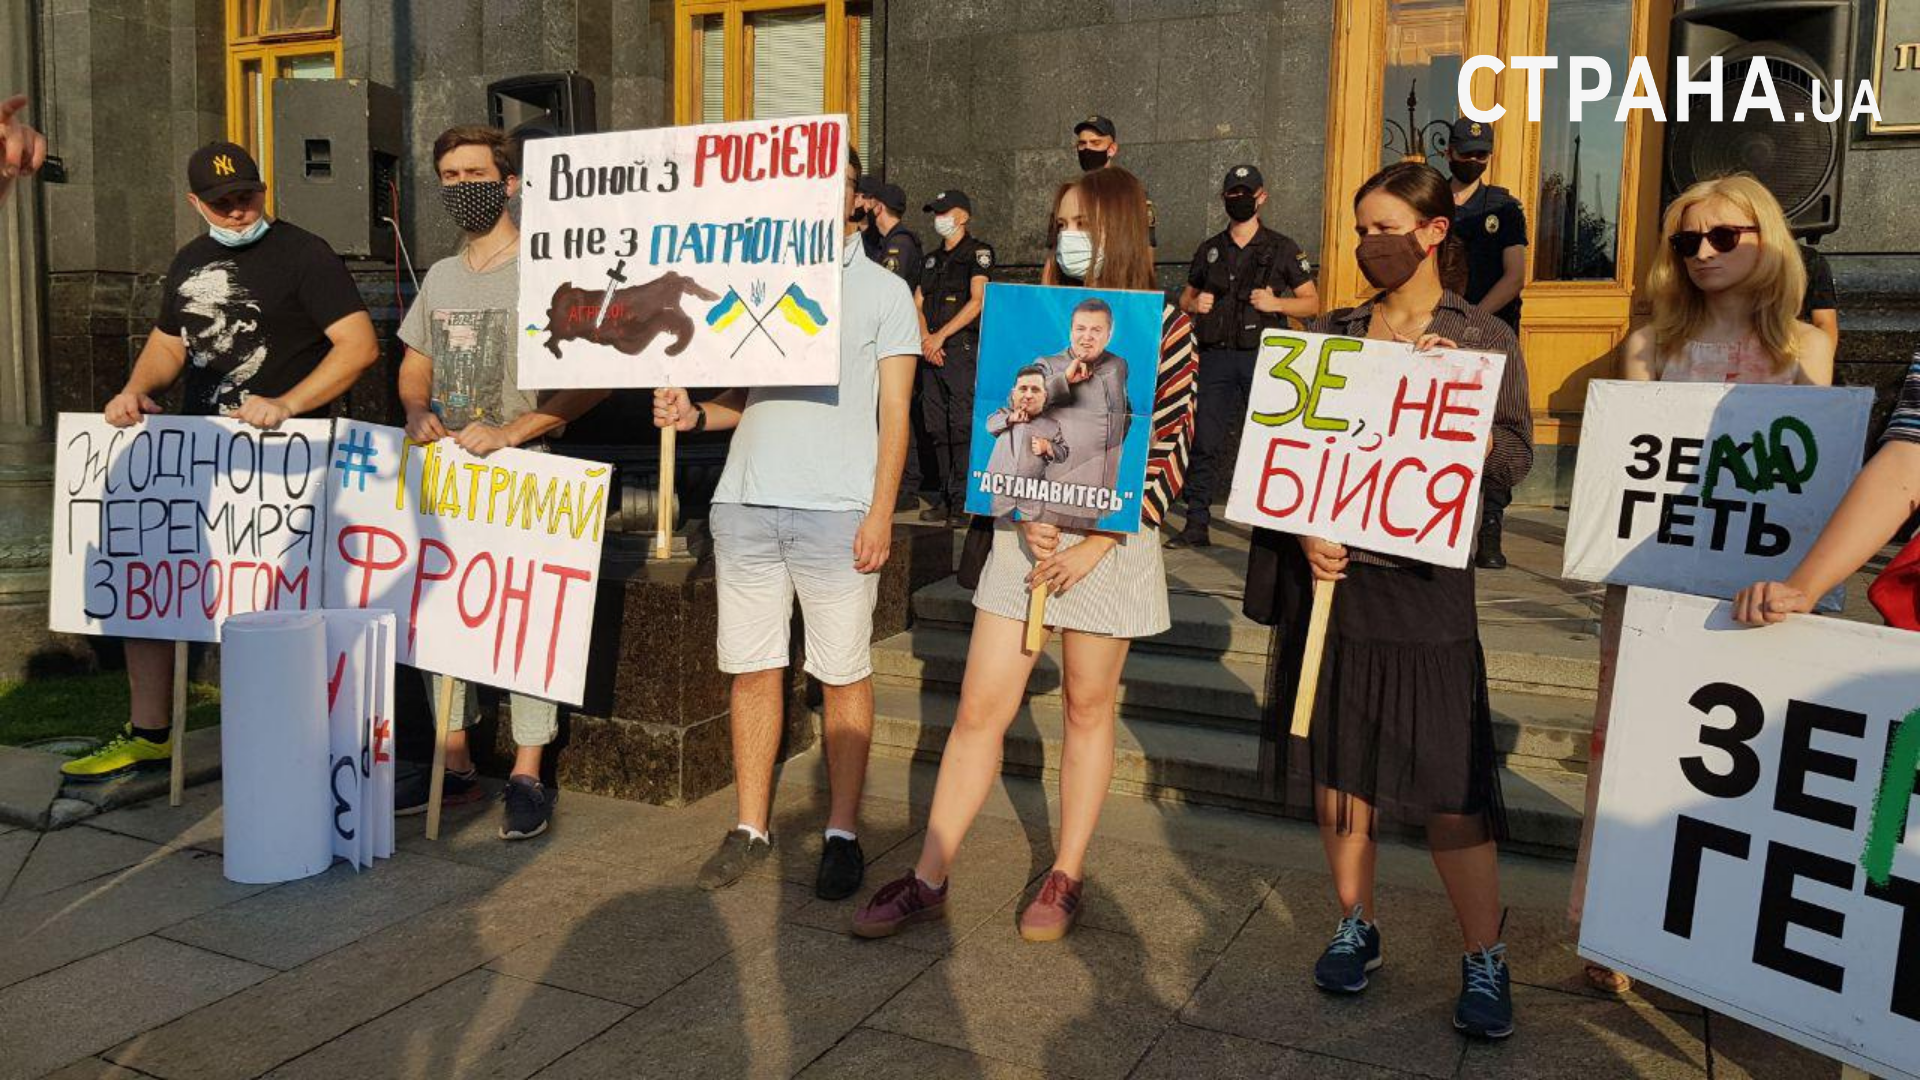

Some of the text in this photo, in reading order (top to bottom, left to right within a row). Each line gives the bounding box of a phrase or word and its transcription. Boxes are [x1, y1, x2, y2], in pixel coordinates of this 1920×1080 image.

[549, 153, 650, 201] Воюй
[657, 160, 680, 193] з
[531, 231, 553, 261] а
[564, 227, 606, 259] не
[614, 227, 638, 257] з
[1388, 375, 1483, 442] НЕ
[67, 429, 311, 502] ЖОДНОГО
[973, 471, 1134, 511] "АСТАНАВИТЕСЬ"
[1256, 432, 1476, 548] БІЙСЯ
[1617, 488, 1792, 557] ГЕТЬ
[126, 559, 310, 620] ВОРОГОМ
[337, 525, 592, 694] ФРОНТ
